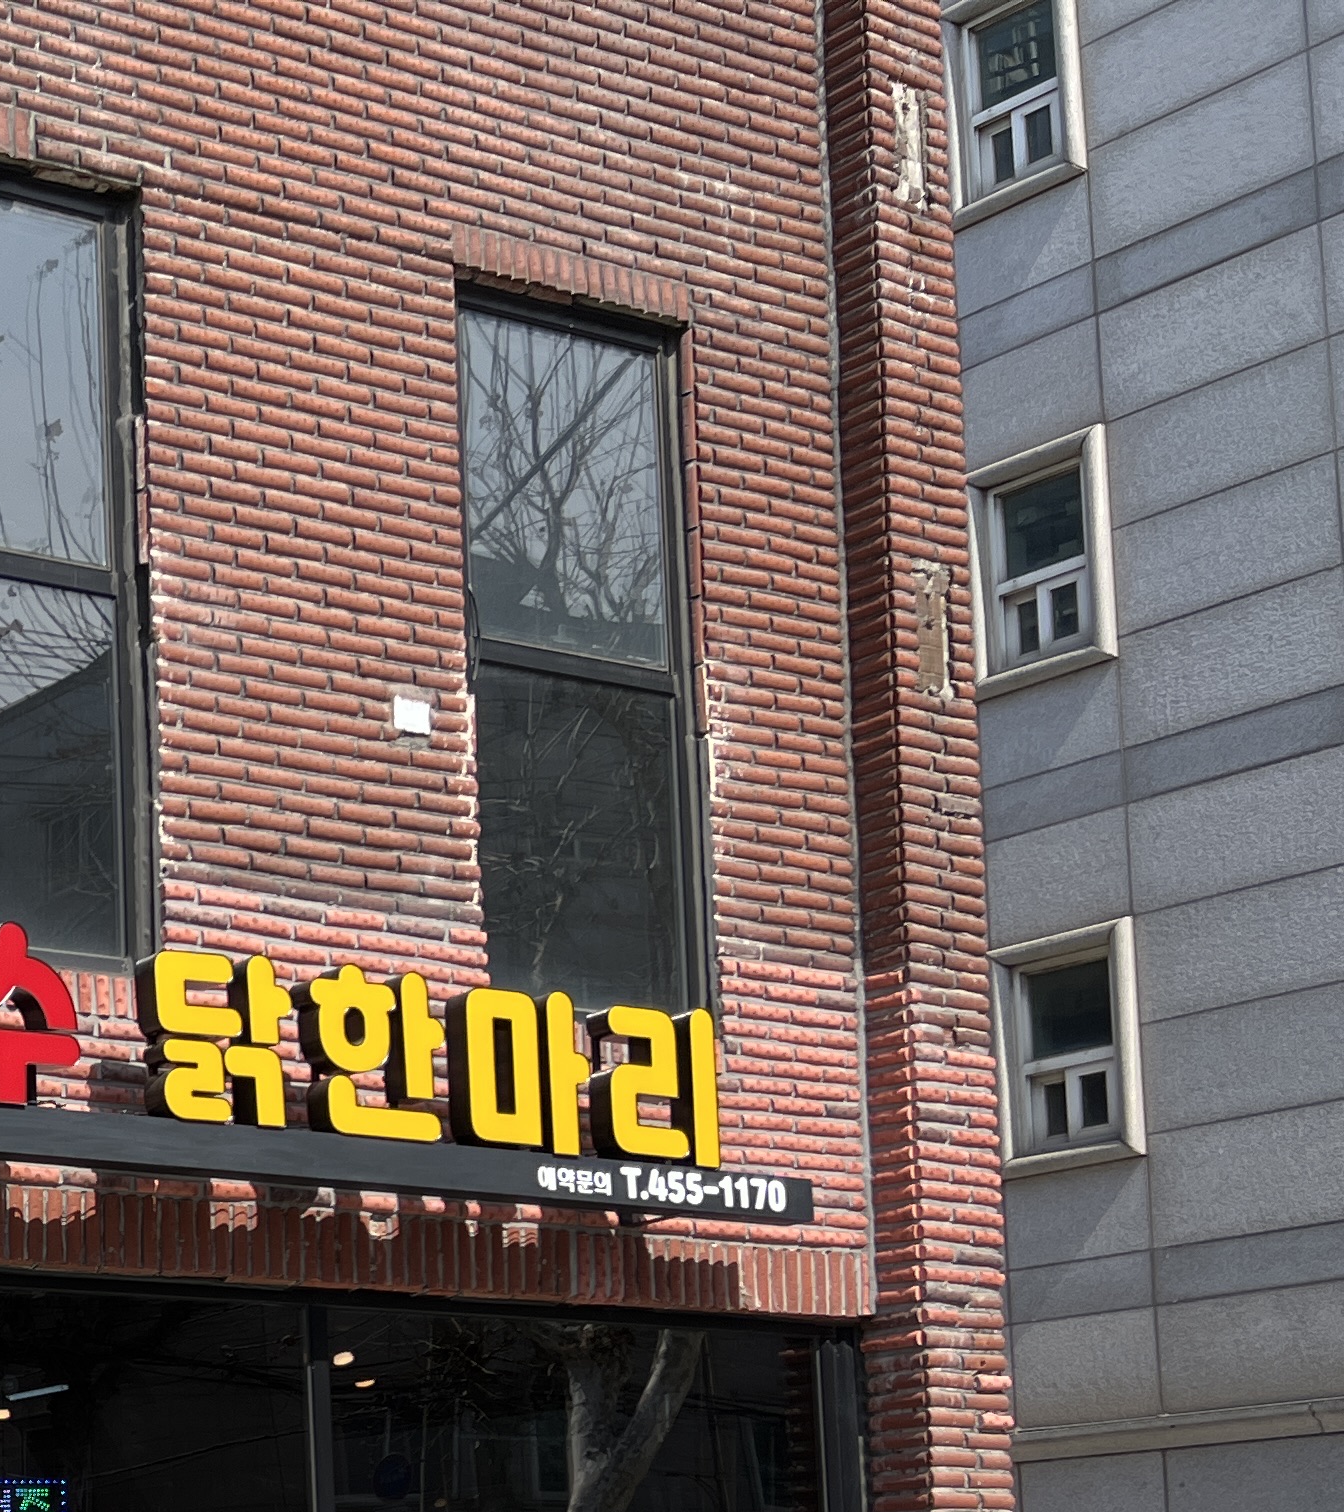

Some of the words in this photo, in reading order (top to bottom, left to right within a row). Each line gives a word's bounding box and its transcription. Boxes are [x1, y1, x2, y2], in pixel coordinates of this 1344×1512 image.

[144, 949, 721, 1169] 닭한마리
[537, 1165, 612, 1196] 예약문의
[619, 1166, 788, 1213] T.455-1170
